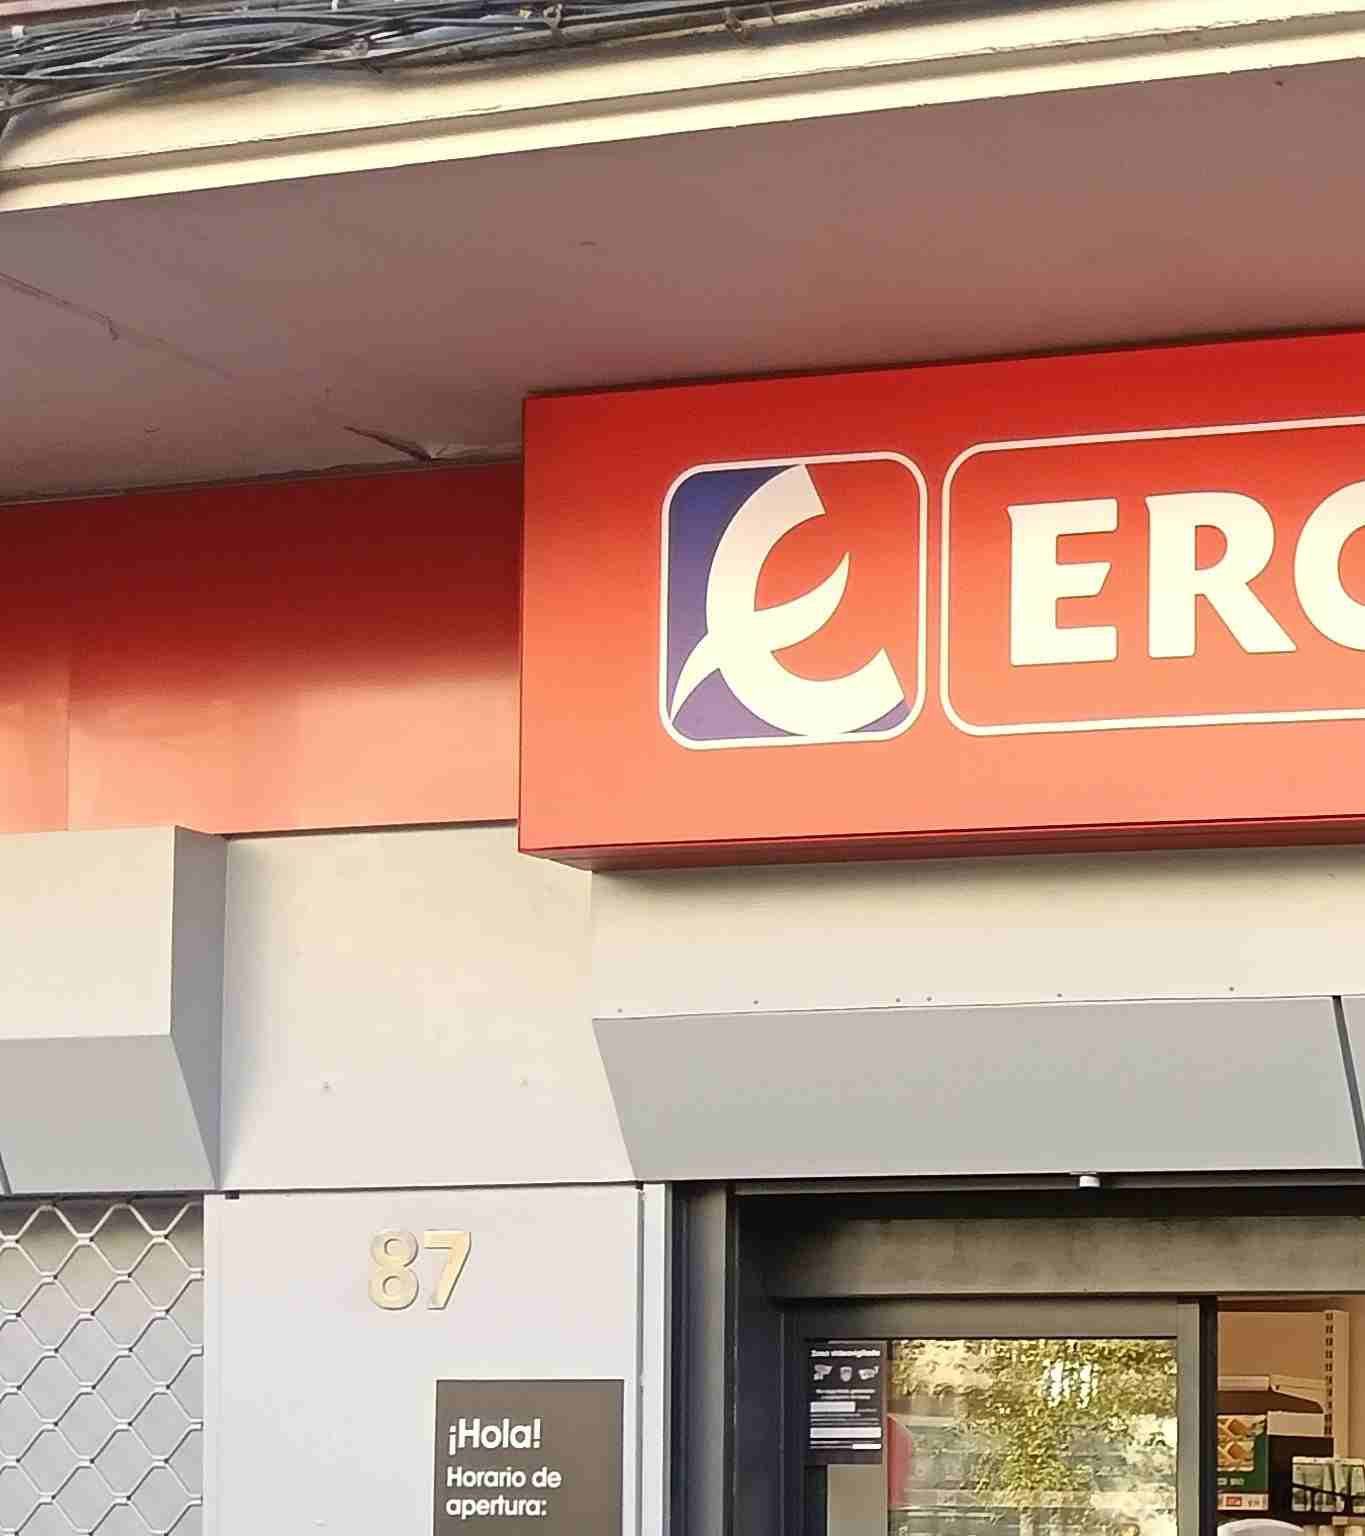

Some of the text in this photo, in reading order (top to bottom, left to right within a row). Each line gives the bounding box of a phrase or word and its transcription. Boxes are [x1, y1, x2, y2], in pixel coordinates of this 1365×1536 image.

[367, 1229, 473, 1311] 87
[448, 1417, 542, 1456] ¡Hola!
[446, 1465, 562, 1489] Horario de
[445, 1494, 548, 1520] apertura:
